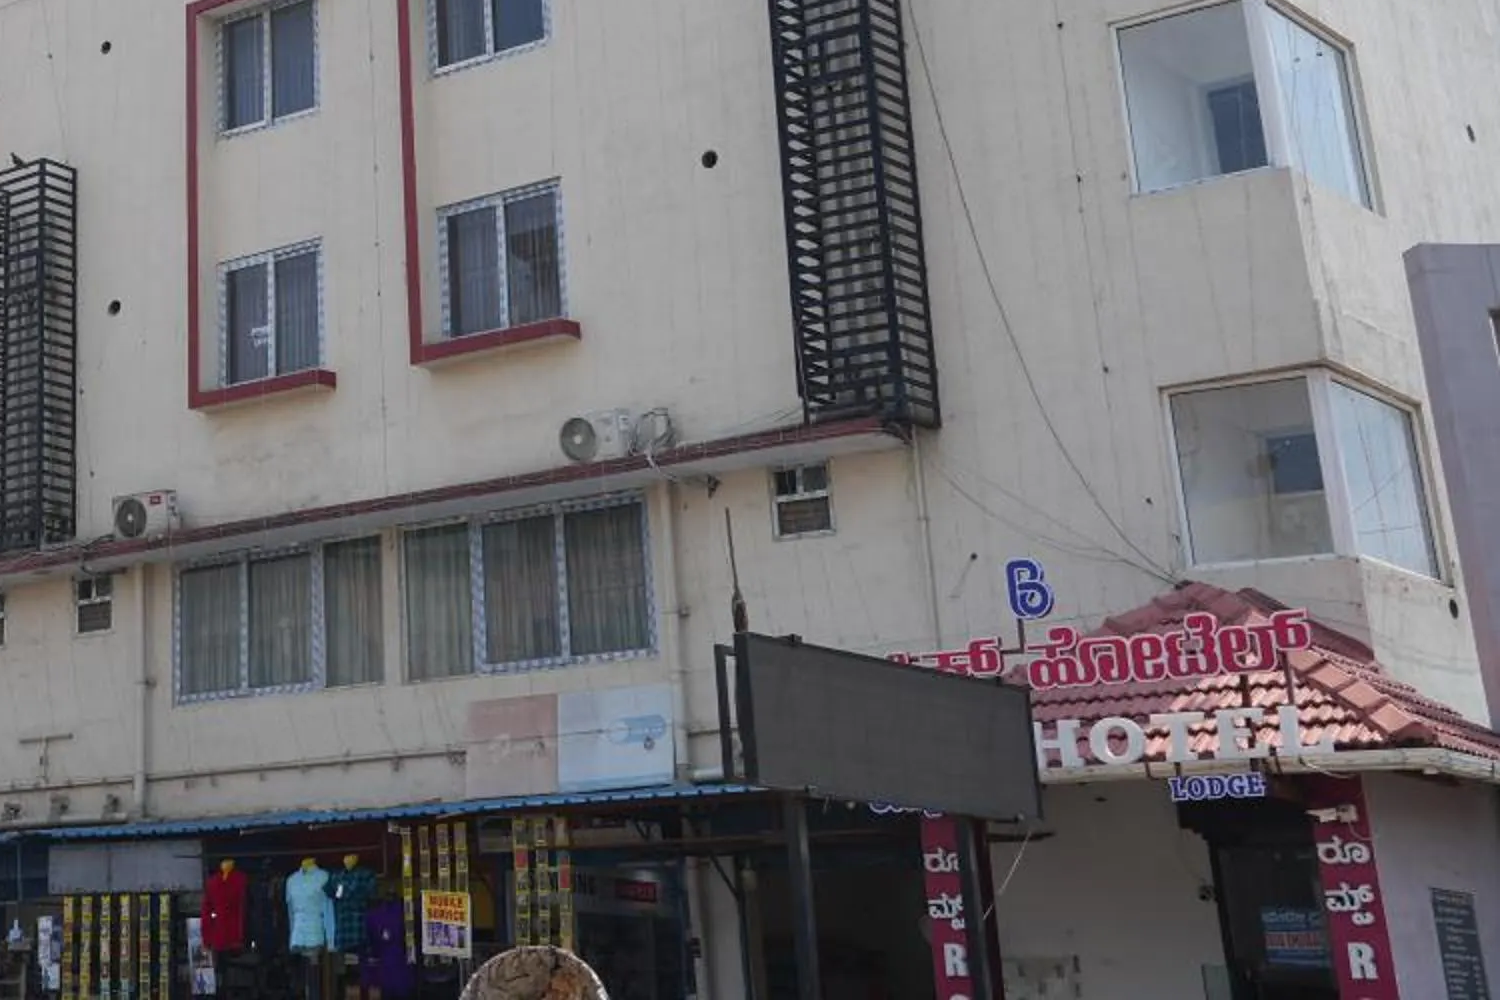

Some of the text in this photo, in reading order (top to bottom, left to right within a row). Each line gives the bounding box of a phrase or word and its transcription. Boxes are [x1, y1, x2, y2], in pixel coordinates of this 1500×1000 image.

[1026, 608, 1312, 691] ಹೋಟೆಲ್
[1033, 704, 1336, 769] HOTEL
[1169, 771, 1267, 801] LODGE
